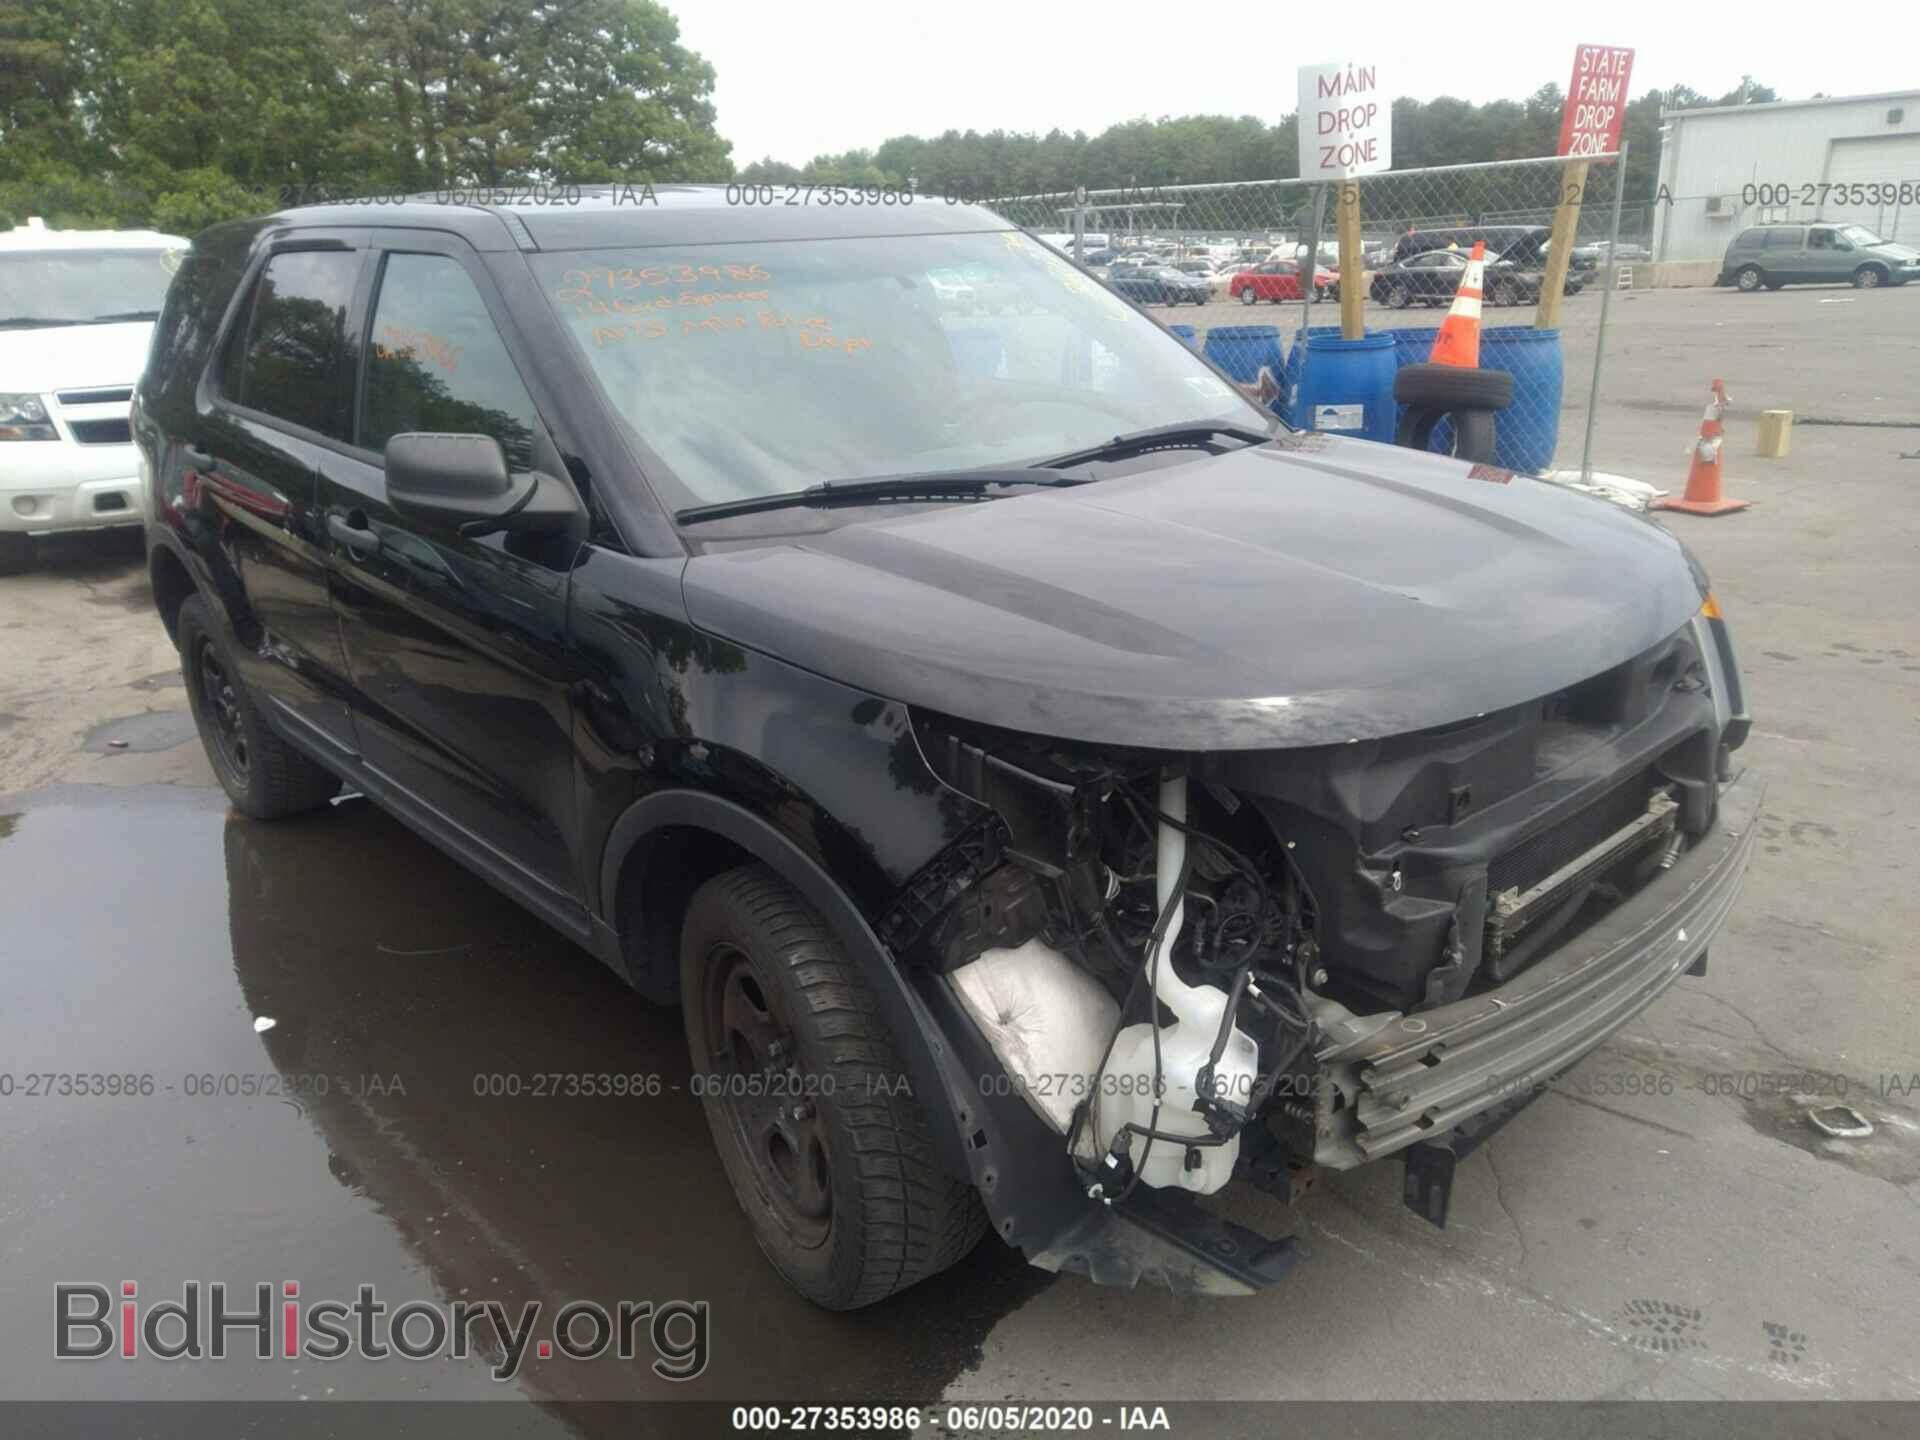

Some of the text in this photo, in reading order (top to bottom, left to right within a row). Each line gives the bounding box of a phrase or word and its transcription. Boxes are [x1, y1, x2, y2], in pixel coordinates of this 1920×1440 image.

[1580, 47, 1629, 76] STATE
[1318, 65, 1376, 98] MAIN
[1577, 76, 1621, 102] FARM
[1318, 103, 1377, 135] DROP
[1574, 104, 1615, 129] DROP
[1319, 138, 1377, 169] ZONE
